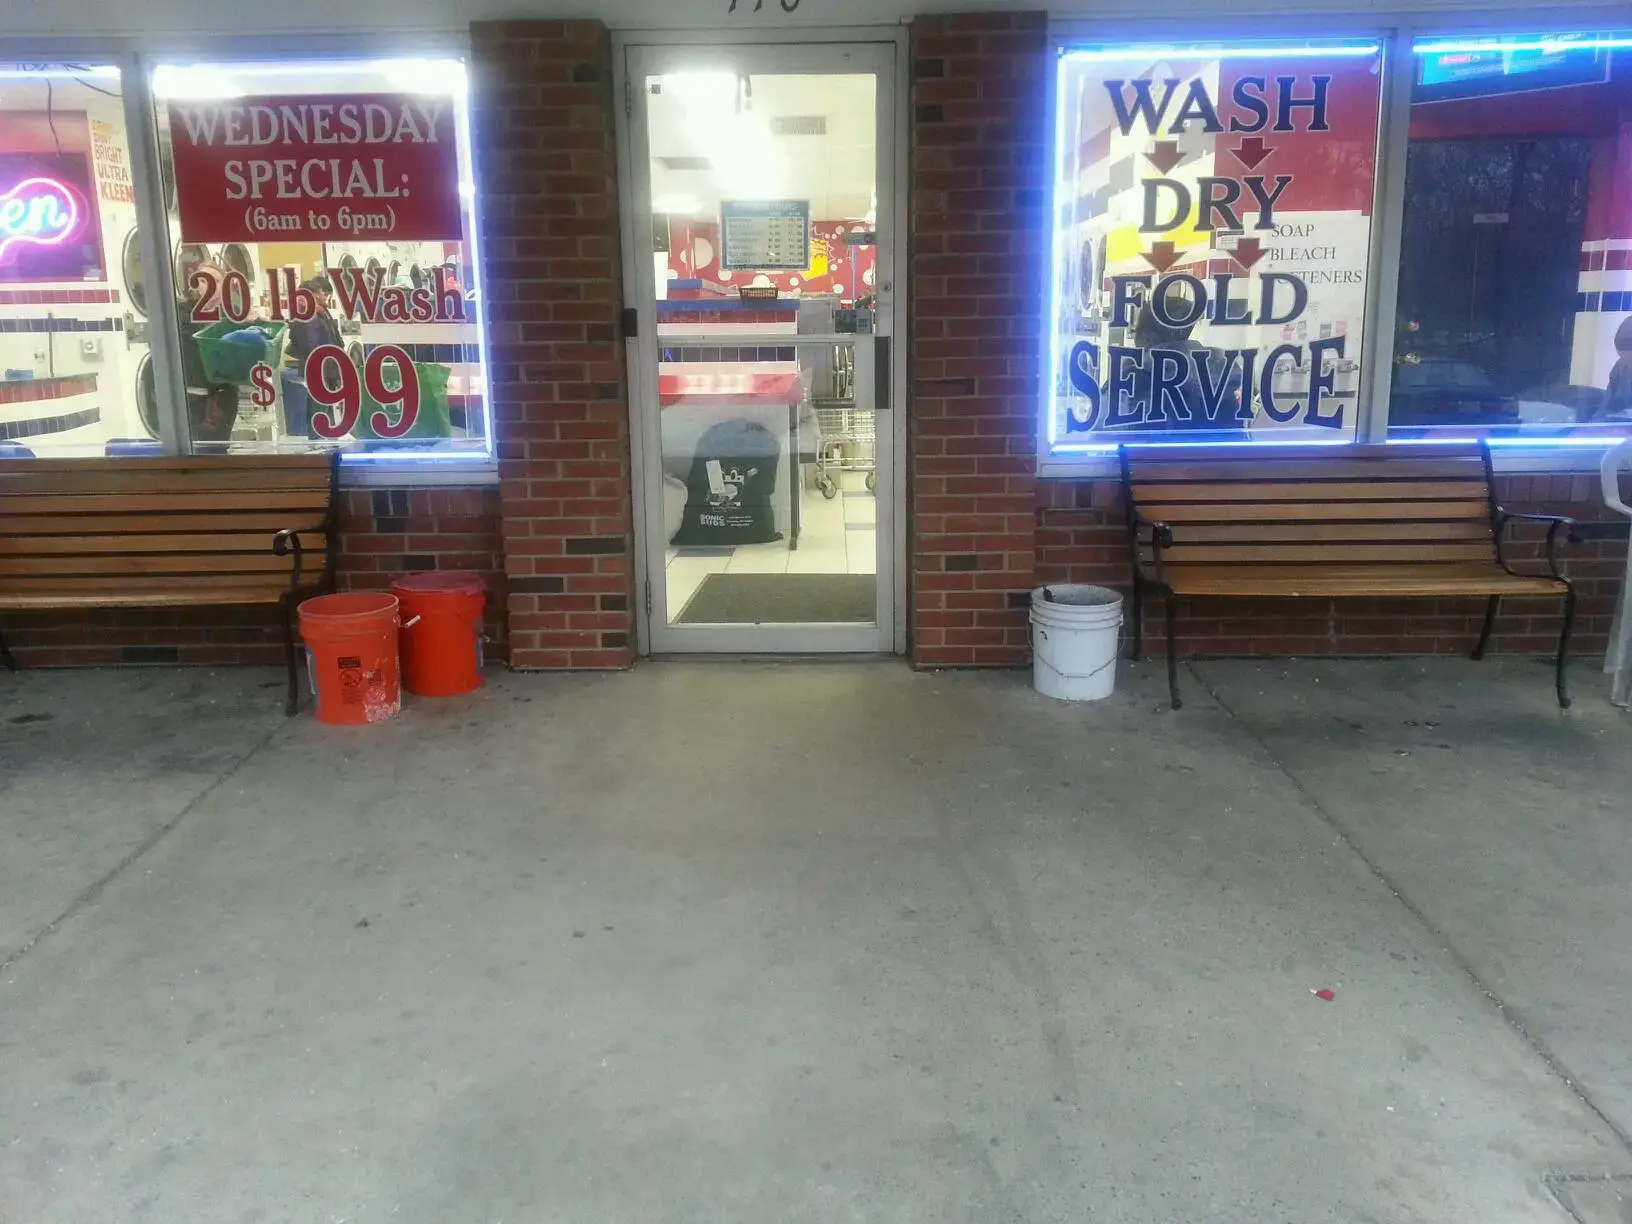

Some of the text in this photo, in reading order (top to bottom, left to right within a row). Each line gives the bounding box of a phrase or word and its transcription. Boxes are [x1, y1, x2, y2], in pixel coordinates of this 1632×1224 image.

[178, 103, 441, 146] WEDNESDAY
[1104, 76, 1331, 136] WASH
[95, 142, 122, 163] BRIGHT
[97, 161, 129, 182] ULTRA
[100, 180, 136, 204] KLEEN
[224, 158, 411, 200] SPECIAL:
[244, 206, 397, 234] (6am to 6pm)
[1139, 175, 1292, 233] DRY
[1271, 223, 1315, 238] SOAP
[1269, 247, 1336, 261] BLEACH
[191, 267, 466, 322] 20 lb Wash
[1277, 270, 1362, 285] TENERS
[1109, 273, 1308, 328] FOLD
[250, 344, 421, 439] $ 99
[1067, 336, 1346, 432] SERVICE
